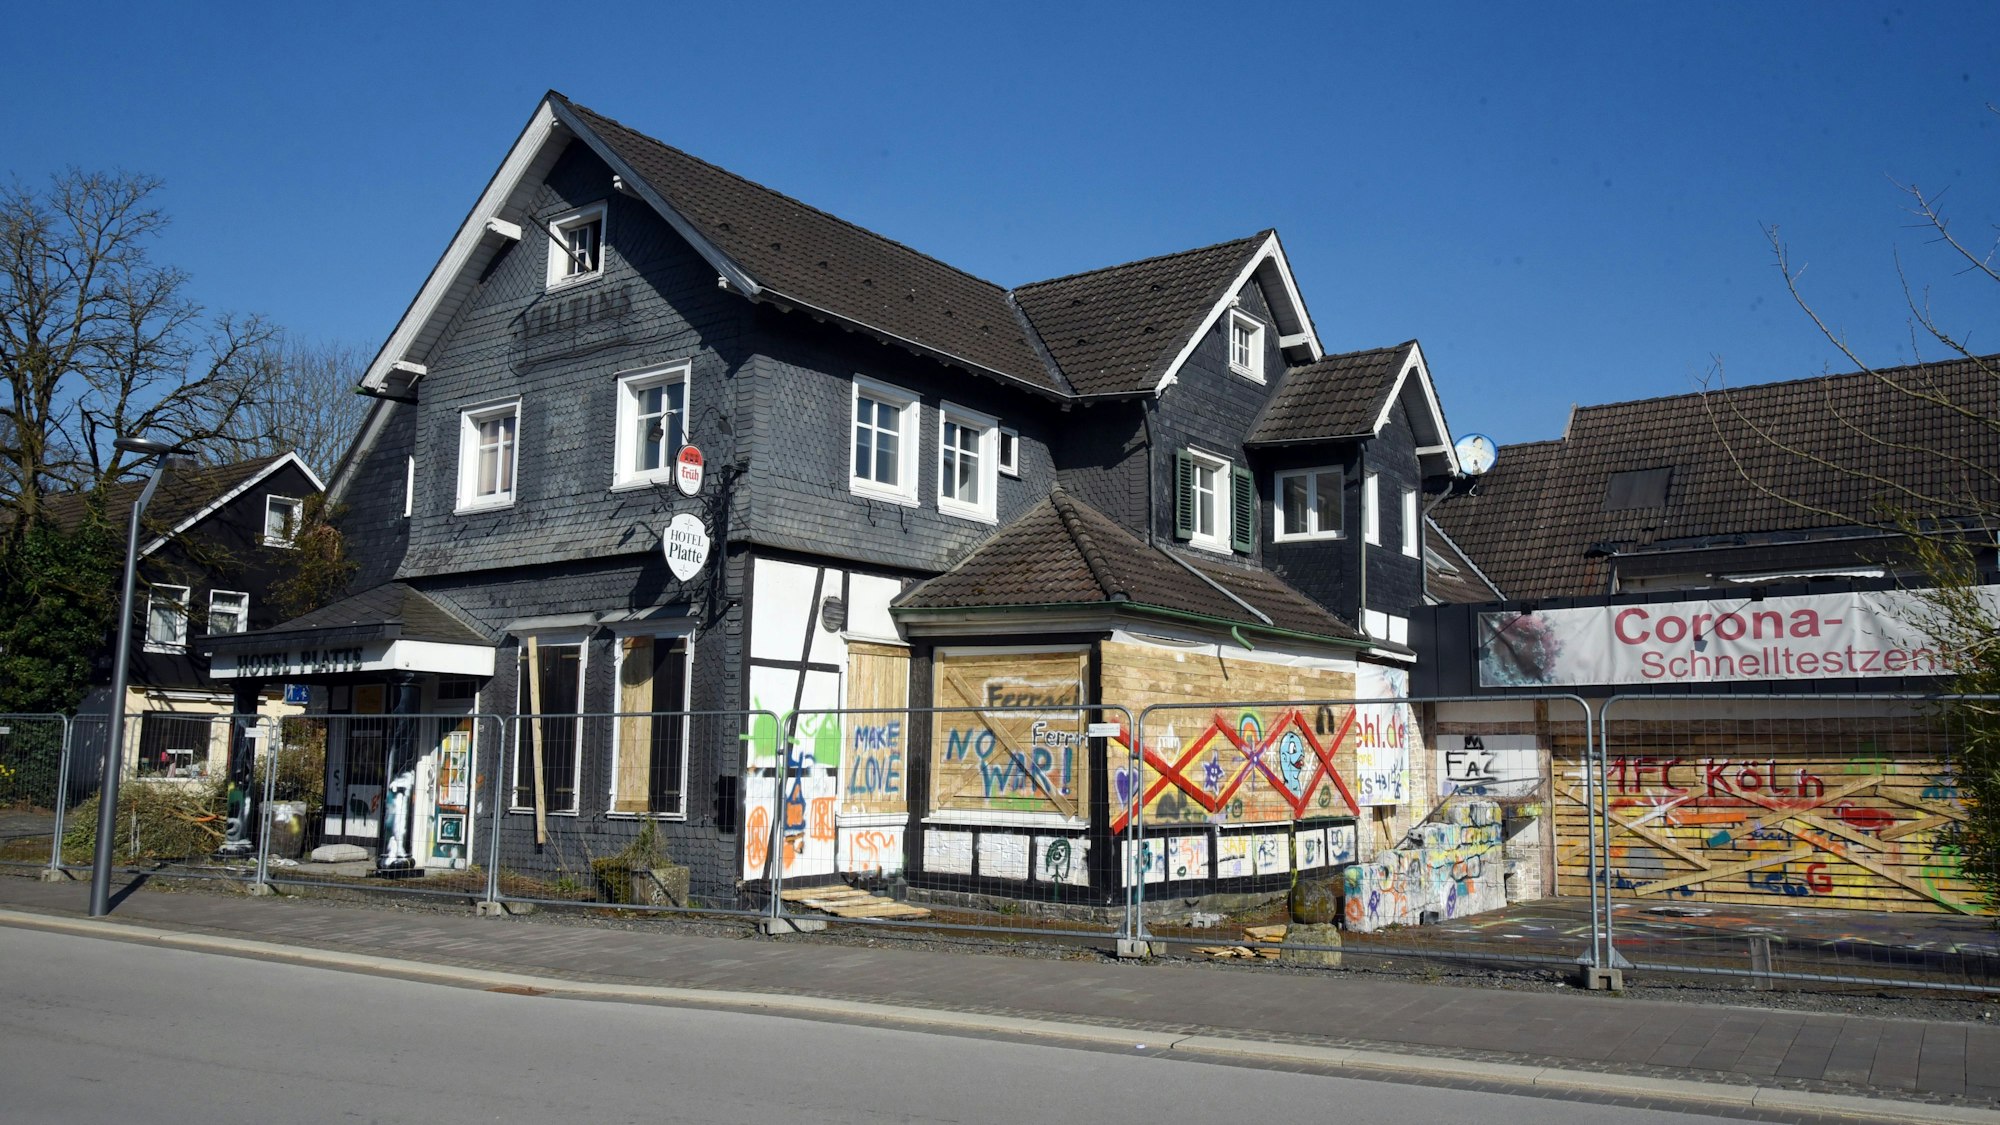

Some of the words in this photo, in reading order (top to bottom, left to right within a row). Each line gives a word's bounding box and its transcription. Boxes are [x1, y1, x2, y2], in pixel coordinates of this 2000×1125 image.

[669, 542, 702, 564] Platte
[671, 530, 703, 547] HOTEL
[1614, 607, 1842, 645] Corona-
[236, 653, 291, 677] HOTEL
[300, 648, 362, 674] PLATTE
[854, 721, 900, 751] MAKE
[945, 727, 996, 761] NO
[848, 752, 900, 795] LOVE
